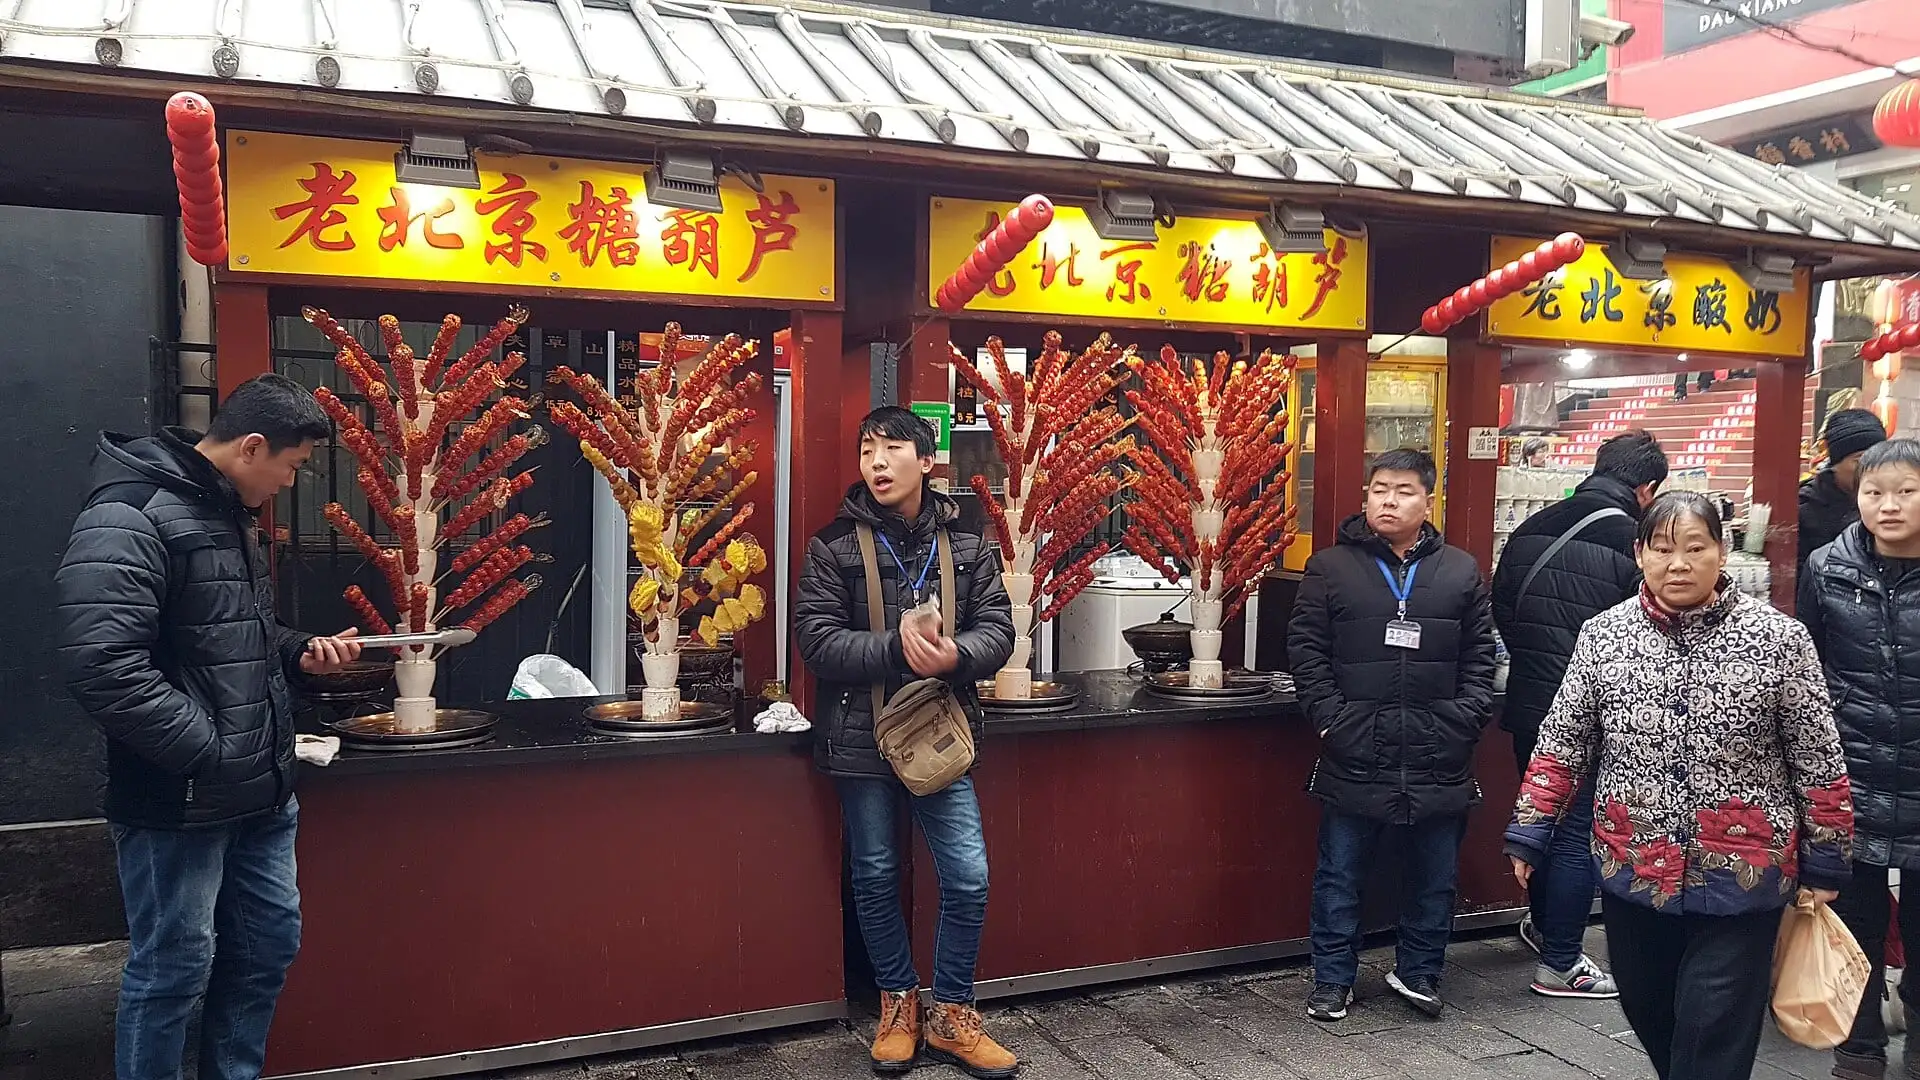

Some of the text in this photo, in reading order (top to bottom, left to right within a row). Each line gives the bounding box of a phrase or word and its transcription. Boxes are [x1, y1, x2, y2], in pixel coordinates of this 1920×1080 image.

[275, 162, 801, 283] 老北京糖葫芦
[1519, 267, 1783, 335] 老北京酸奶
[617, 339, 638, 406] 精品水果
